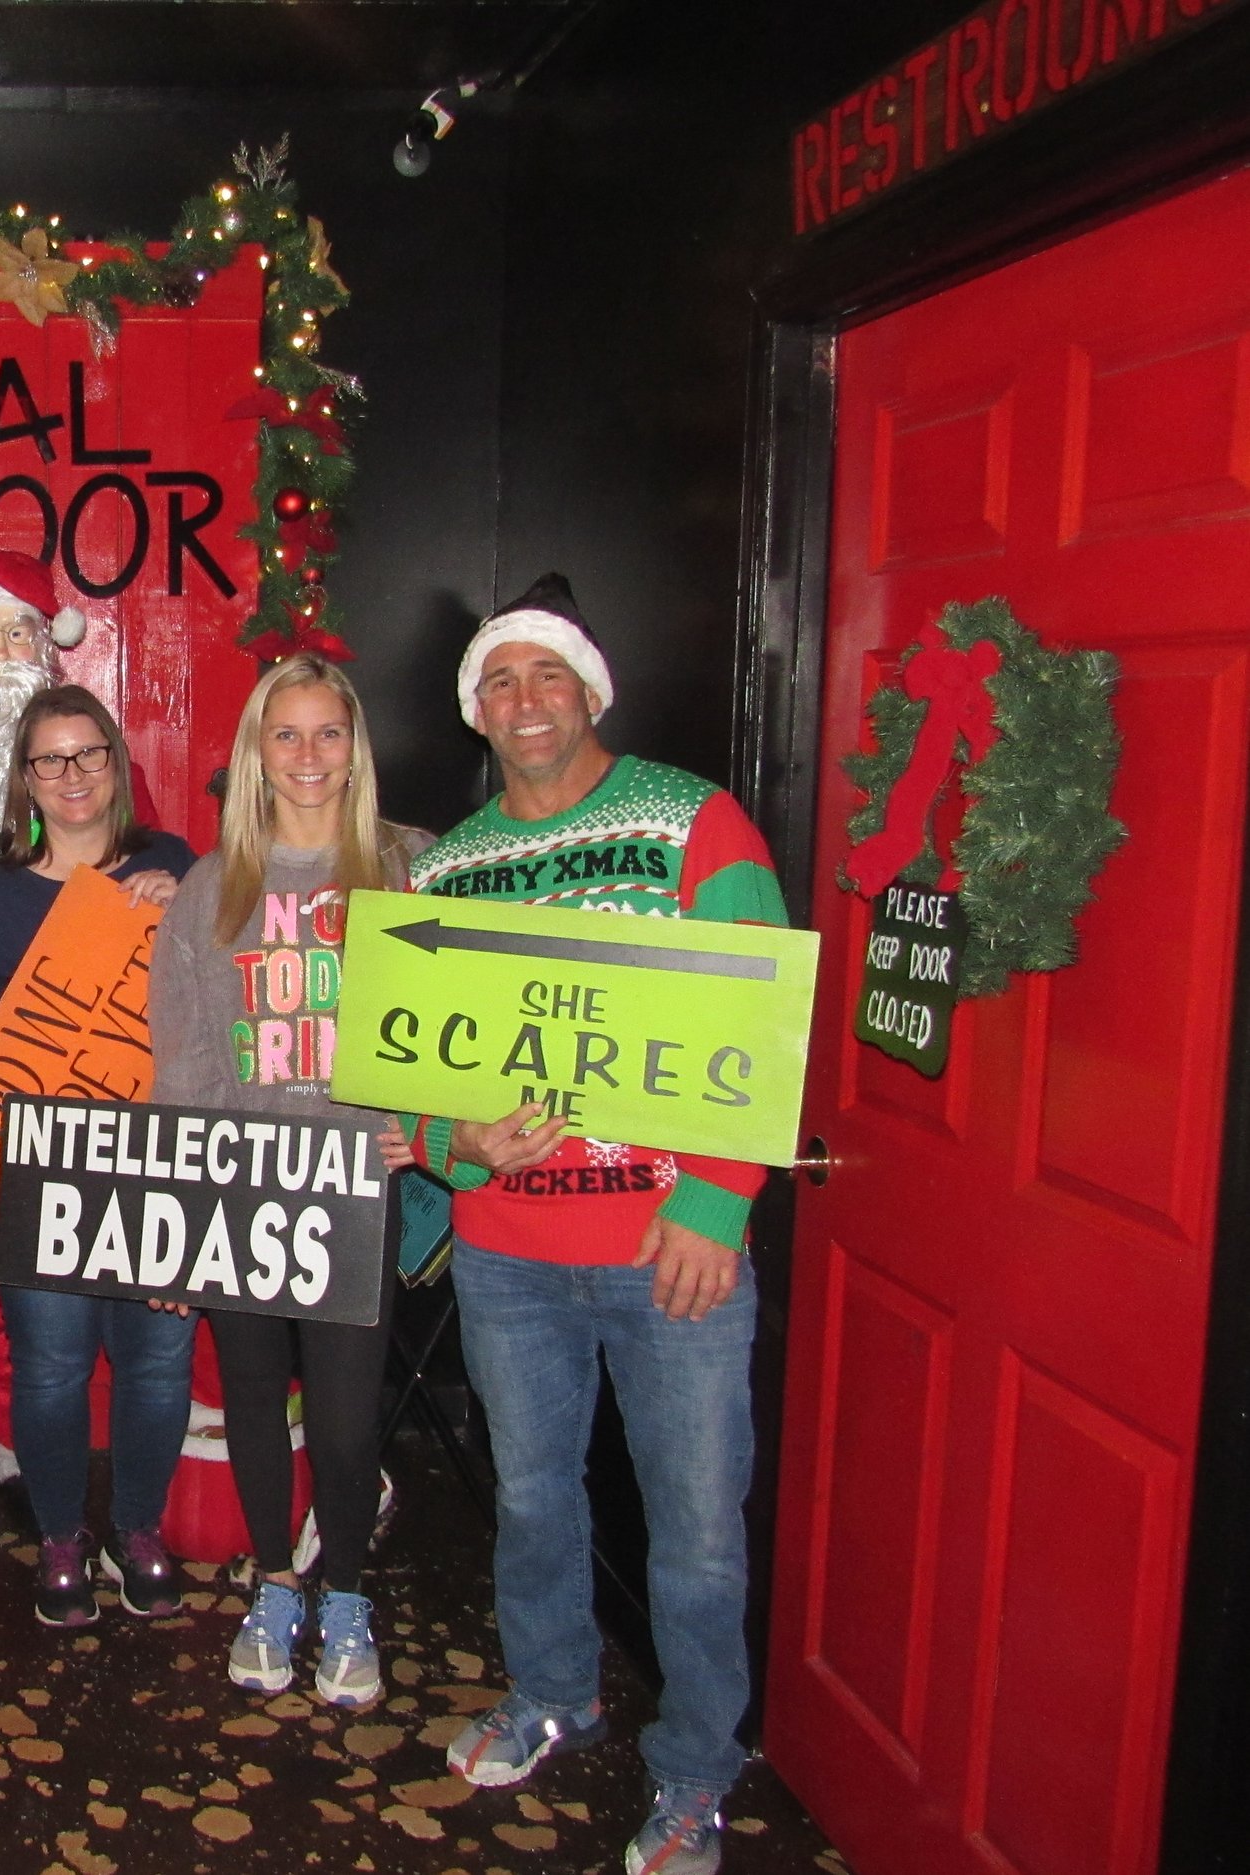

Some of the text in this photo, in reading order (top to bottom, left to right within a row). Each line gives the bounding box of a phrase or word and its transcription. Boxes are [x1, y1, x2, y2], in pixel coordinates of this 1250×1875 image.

[793, 0, 1228, 235] RESTROO
[553, 845, 669, 884] XMAS
[261, 893, 346, 945] NO
[886, 887, 948, 929] PLEASE
[233, 948, 342, 1014] TOD
[866, 931, 950, 985] KEEP DOOR
[1, 955, 104, 1057] WE
[519, 980, 608, 1024] SHE
[867, 990, 932, 1049] CLOSED
[376, 1007, 752, 1107] SCARES
[286, 1083, 319, 1096] simply
[521, 1085, 586, 1127] ME
[6, 1103, 382, 1198] INTELLECTUAL
[493, 1164, 656, 1195] UCKERS
[35, 1181, 333, 1306] BADASS
